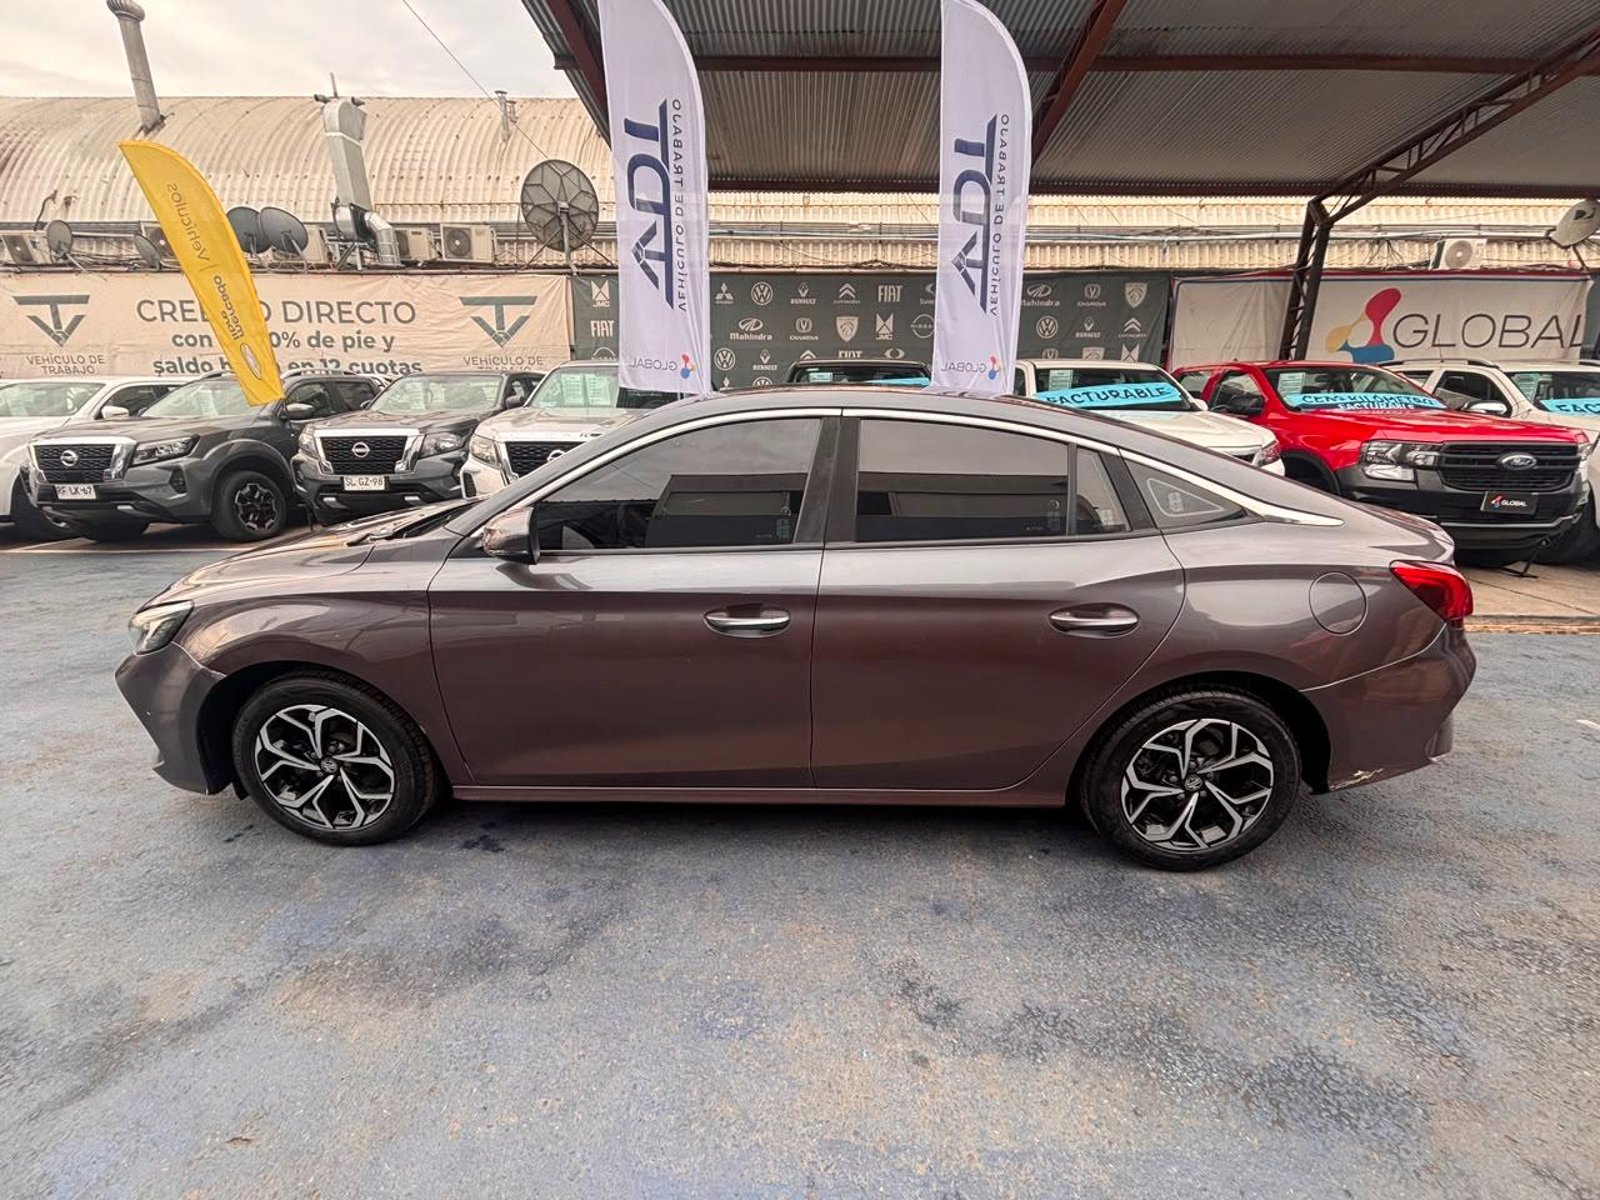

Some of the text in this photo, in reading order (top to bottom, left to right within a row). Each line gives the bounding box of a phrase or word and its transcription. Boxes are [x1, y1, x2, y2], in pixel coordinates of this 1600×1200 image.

[877, 285, 903, 303] FIAT
[283, 300, 417, 324] DIRECTO
[590, 320, 614, 337] FIAT
[729, 332, 773, 341] Mahindra
[1393, 313, 1582, 349] GLOBAL
[172, 333, 213, 348] con
[307, 331, 336, 348] de
[341, 330, 376, 352] pie
[382, 335, 395, 352] y
[26, 354, 106, 365] VEHÍCULO DE
[153, 356, 214, 375] saldo
[348, 360, 423, 375] cuotas
[463, 354, 544, 366] VEHÍCULO DE
[41, 365, 96, 375] TRABAJO
[1501, 499, 1528, 507] GLOBAL
